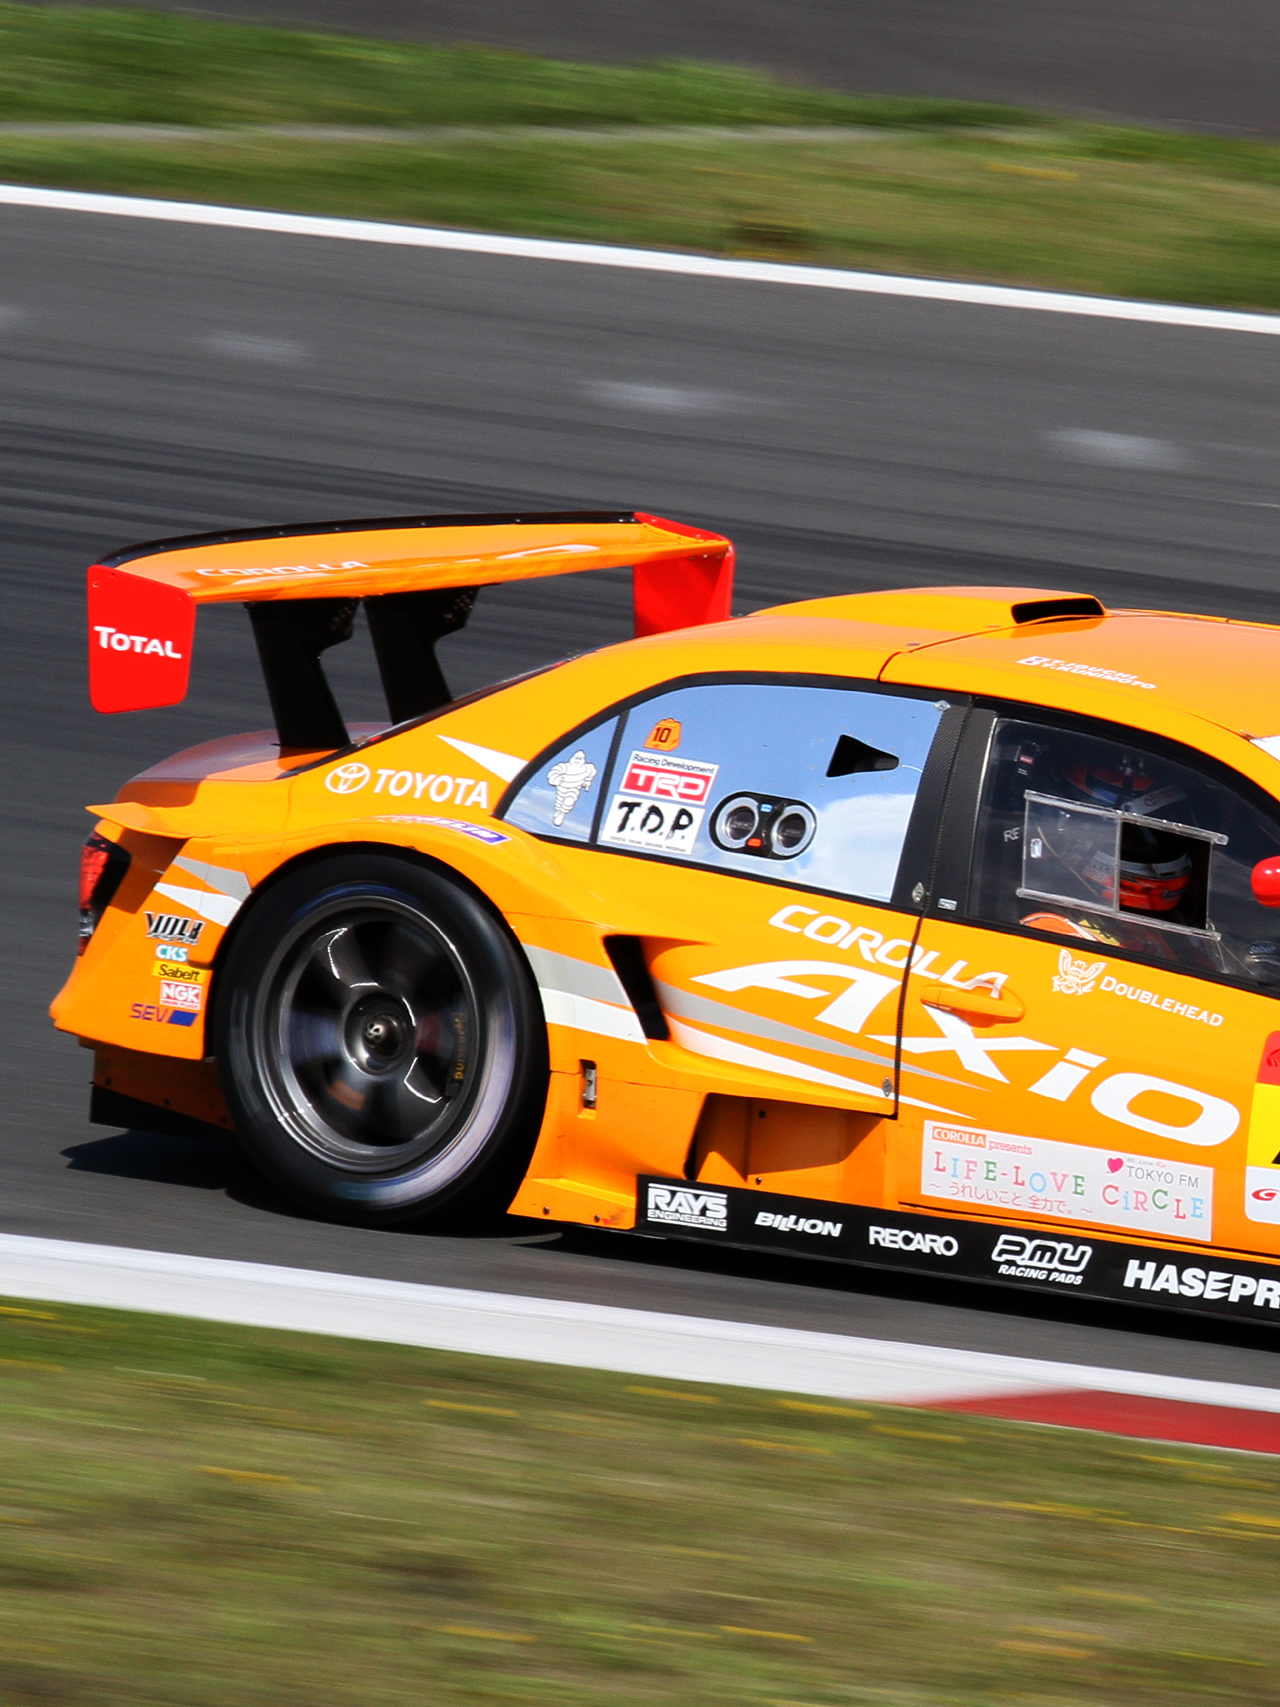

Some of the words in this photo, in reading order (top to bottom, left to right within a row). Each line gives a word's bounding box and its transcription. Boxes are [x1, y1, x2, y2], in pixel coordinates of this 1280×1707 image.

[195, 560, 371, 577] COROLLA
[94, 626, 182, 660] TOTAL
[654, 726, 671, 743] 10
[633, 753, 660, 766] Racing
[661, 759, 715, 775] Development
[373, 768, 489, 810] TOYOTA
[631, 768, 706, 799] TRD
[156, 943, 188, 963] CKS
[768, 904, 1009, 998] COROLLA
[162, 983, 201, 1004] NGK
[130, 1003, 169, 1022] SEV
[932, 1127, 986, 1147] COROLLA
[988, 1140, 1033, 1156] presents
[1126, 1165, 1175, 1185] TOKYO
[1178, 1174, 1200, 1189] FM
[647, 1188, 728, 1218] RAYS
[647, 1208, 728, 1229] ENGINEERING
[754, 1211, 843, 1238] BILLION
[868, 1226, 959, 1257] RECARO
[997, 1263, 1048, 1282] RACING
[1049, 1270, 1084, 1286] PADS
